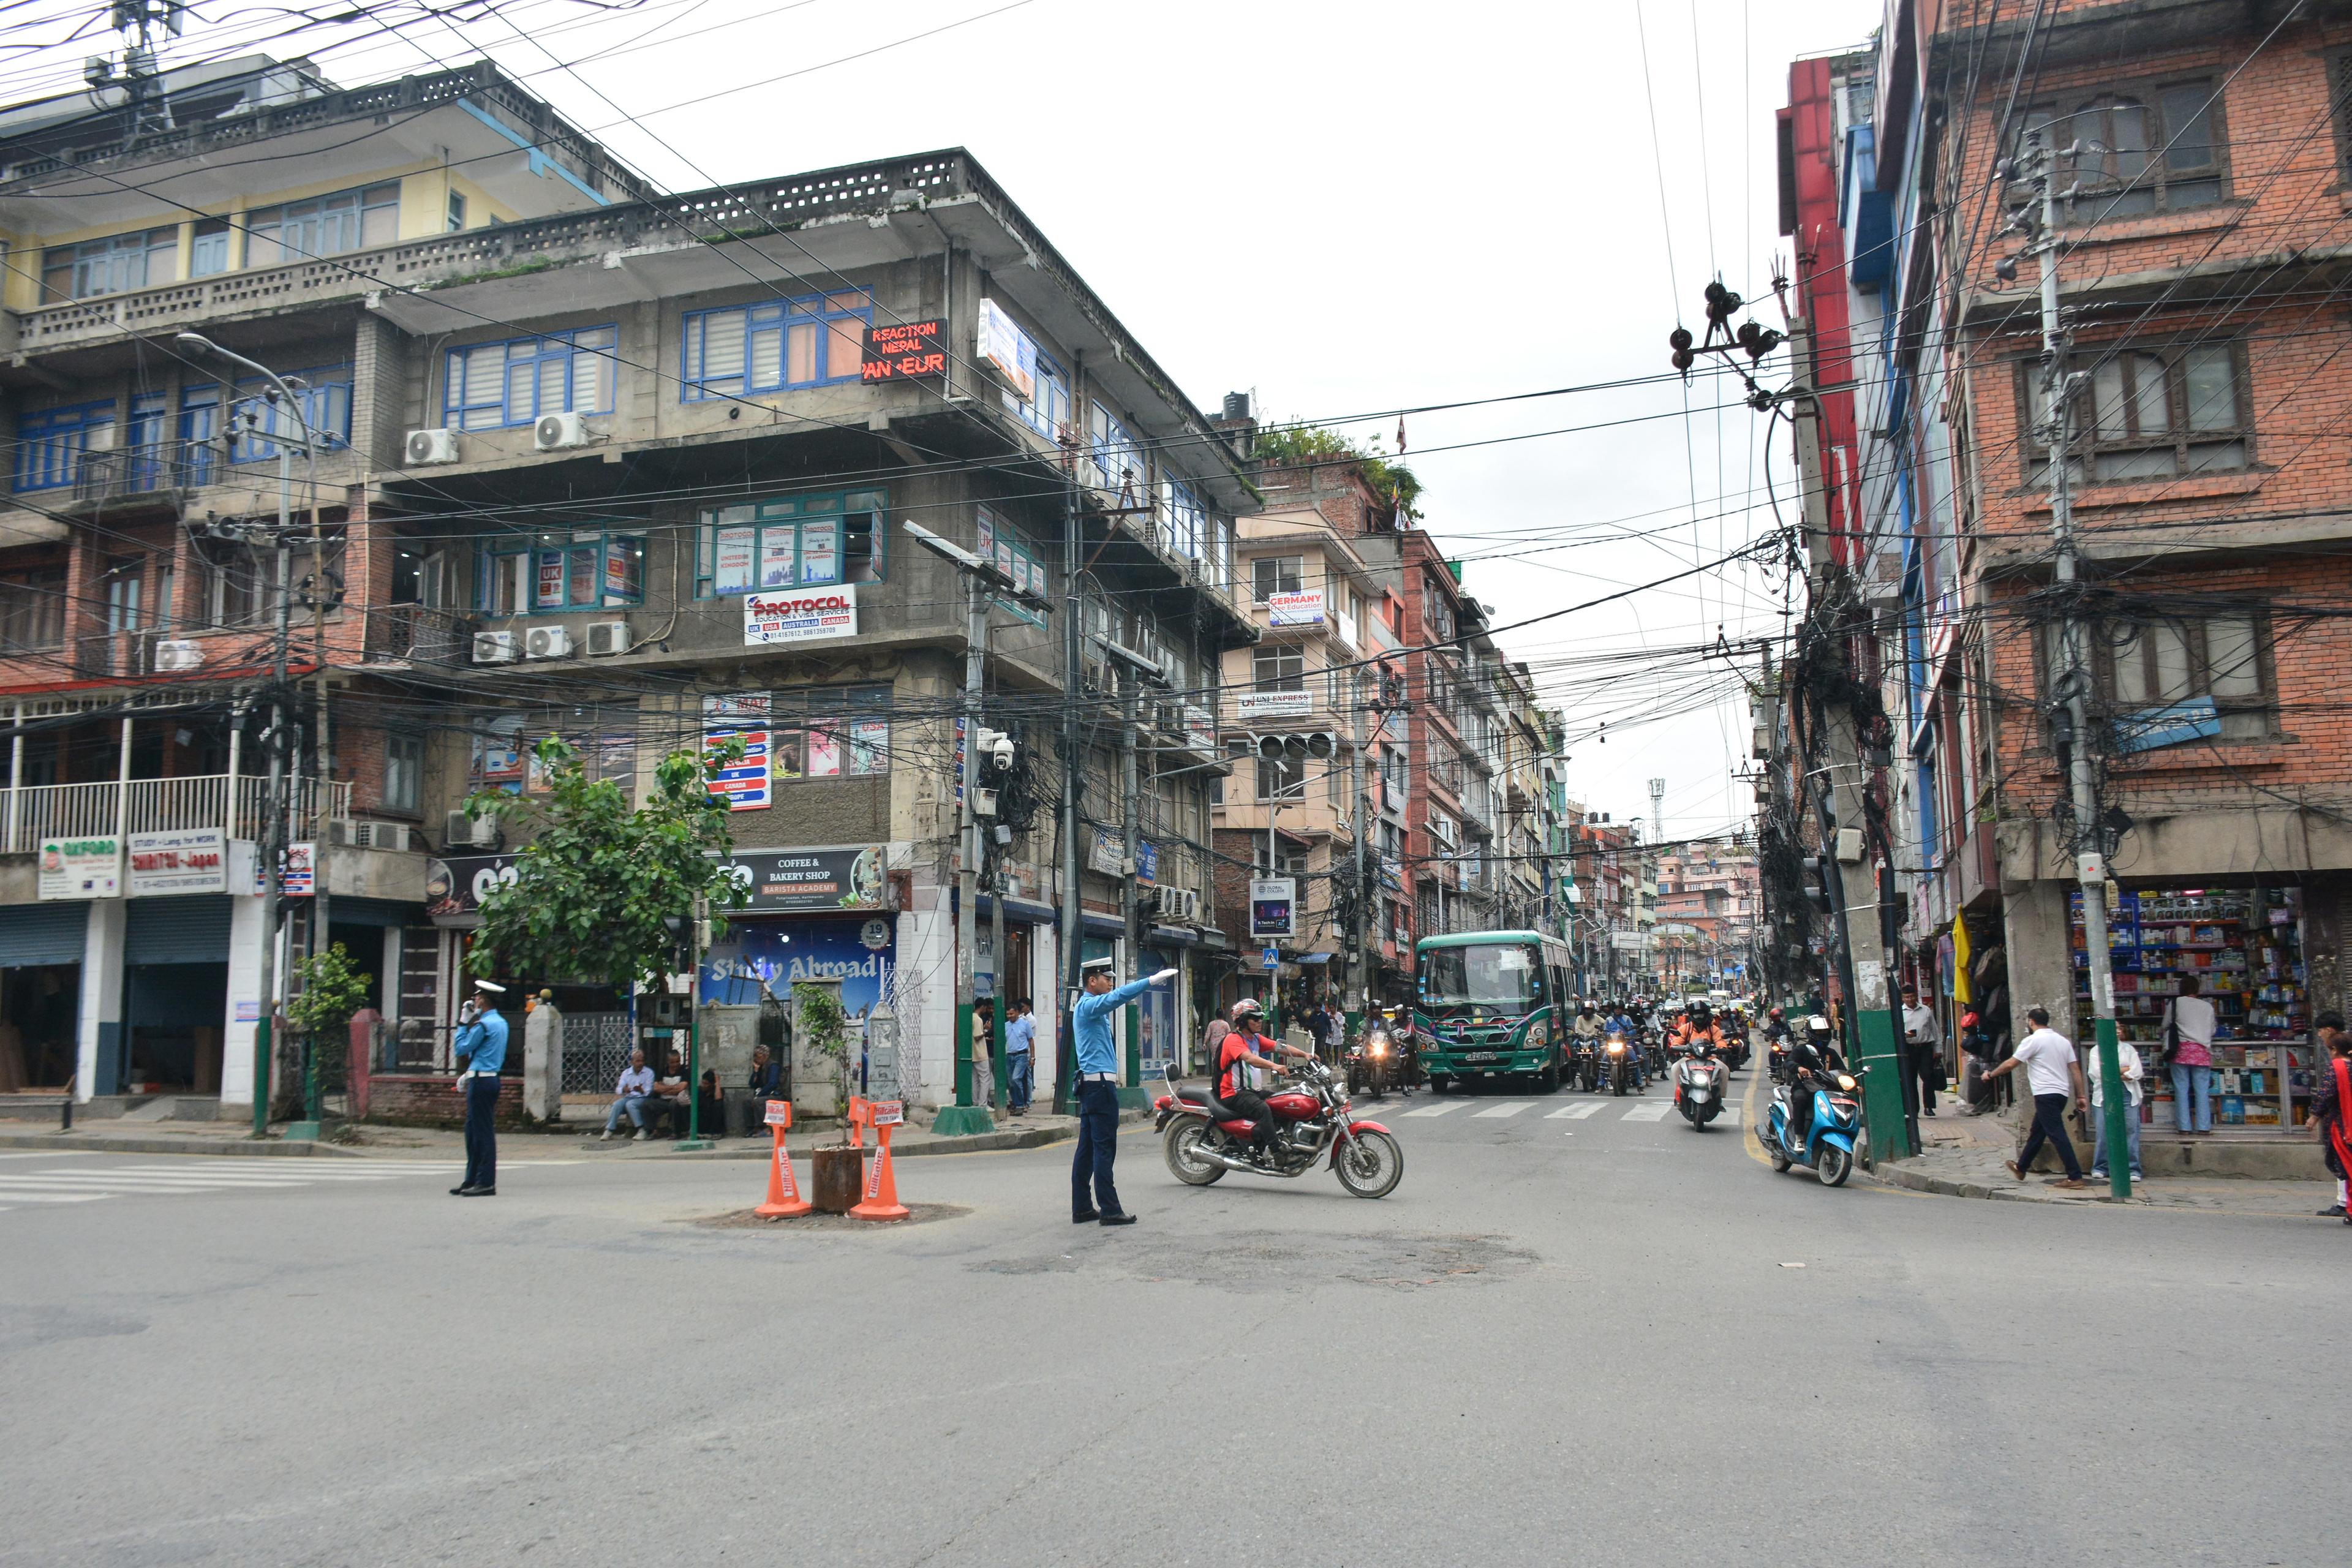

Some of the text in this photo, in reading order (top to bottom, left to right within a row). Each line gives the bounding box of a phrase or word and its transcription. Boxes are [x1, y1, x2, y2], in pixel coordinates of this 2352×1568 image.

[872, 322, 937, 342] REACTION
[882, 339, 922, 354] NEPAL
[979, 531, 992, 552] UK
[543, 567, 560, 579] UK
[1270, 594, 1321, 605] GERMANY
[754, 596, 850, 617] PROTOCOL
[755, 614, 791, 623] EDUCATION
[816, 608, 850, 617] SERVICES
[783, 620, 819, 629] AUSTRALIA
[823, 616, 850, 625] CANADA
[862, 720, 884, 731] USA
[778, 858, 820, 868] COFFEE &
[770, 871, 831, 881] BAKERY SHOP
[869, 924, 883, 934] 19
[788, 953, 877, 981] Abroad
[875, 1106, 900, 1115] Hilltake
[870, 1152, 884, 1194] Hilltake
